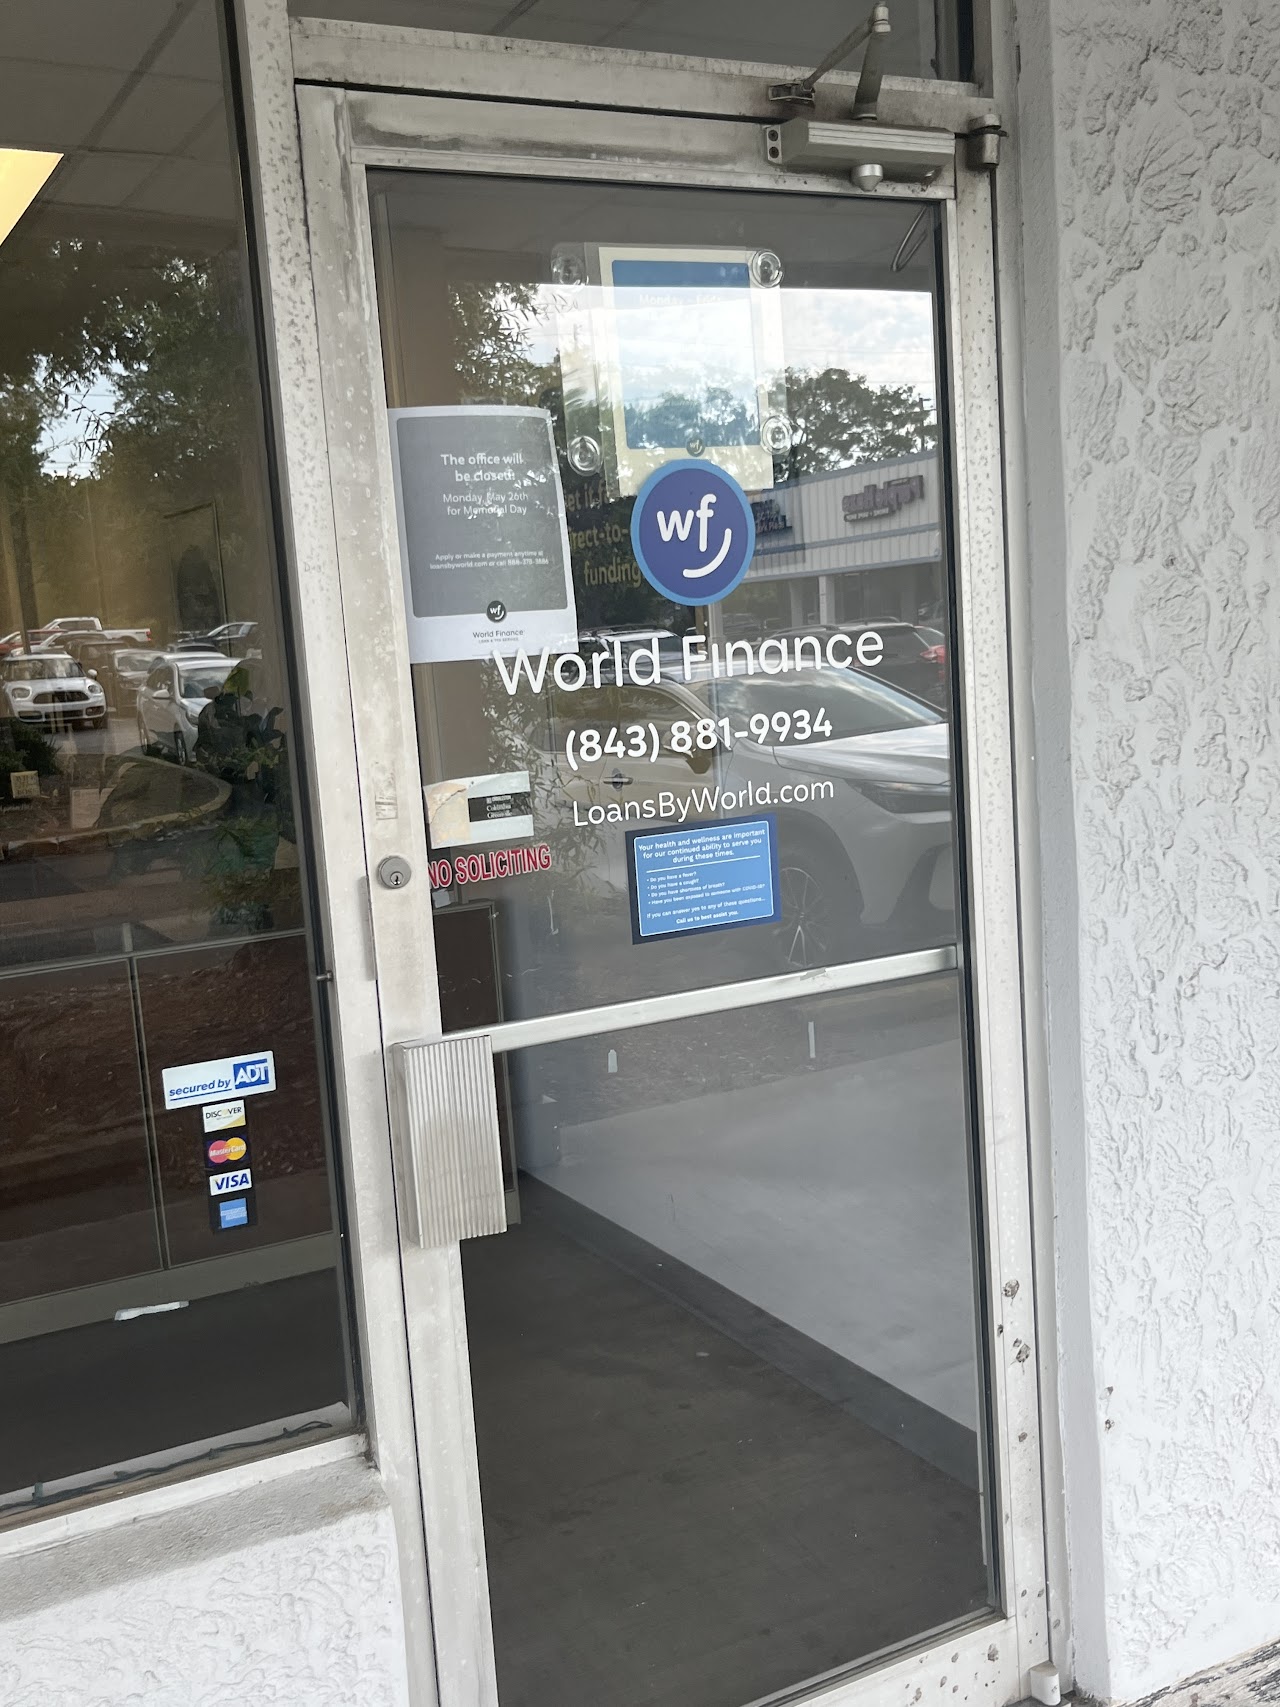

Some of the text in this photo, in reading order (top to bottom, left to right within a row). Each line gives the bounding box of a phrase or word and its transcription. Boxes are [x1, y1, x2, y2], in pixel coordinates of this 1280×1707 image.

[440, 452, 523, 466] The office will
[455, 470, 470, 482] be
[443, 491, 529, 504] Monday, May 26th
[447, 504, 527, 516] for Memorial Day
[656, 493, 717, 552] wf
[435, 553, 454, 562] Apply
[486, 551, 513, 560] payment
[496, 559, 507, 567] call
[583, 555, 641, 588] funding
[489, 604, 502, 616] wf
[472, 629, 524, 639] World Finance
[492, 631, 884, 695] World Finance
[566, 707, 833, 771] (843) 881-9934
[573, 780, 835, 827] LoansByWorld.com
[638, 829, 766, 852] Your health and wellness are important
[643, 852, 654, 860] for
[667, 846, 701, 856] continued
[701, 843, 722, 853] ability
[723, 841, 731, 849] to
[731, 840, 750, 848] serve
[750, 838, 762, 847] you
[672, 849, 735, 864] during these times.
[428, 842, 551, 889] NO SOLICITING
[691, 906, 701, 914] yes
[169, 1063, 269, 1097] secured by ADT
[205, 1106, 242, 1120] DISCOVER
[209, 1144, 247, 1157] MasterCard
[215, 1172, 250, 1190] VISA
